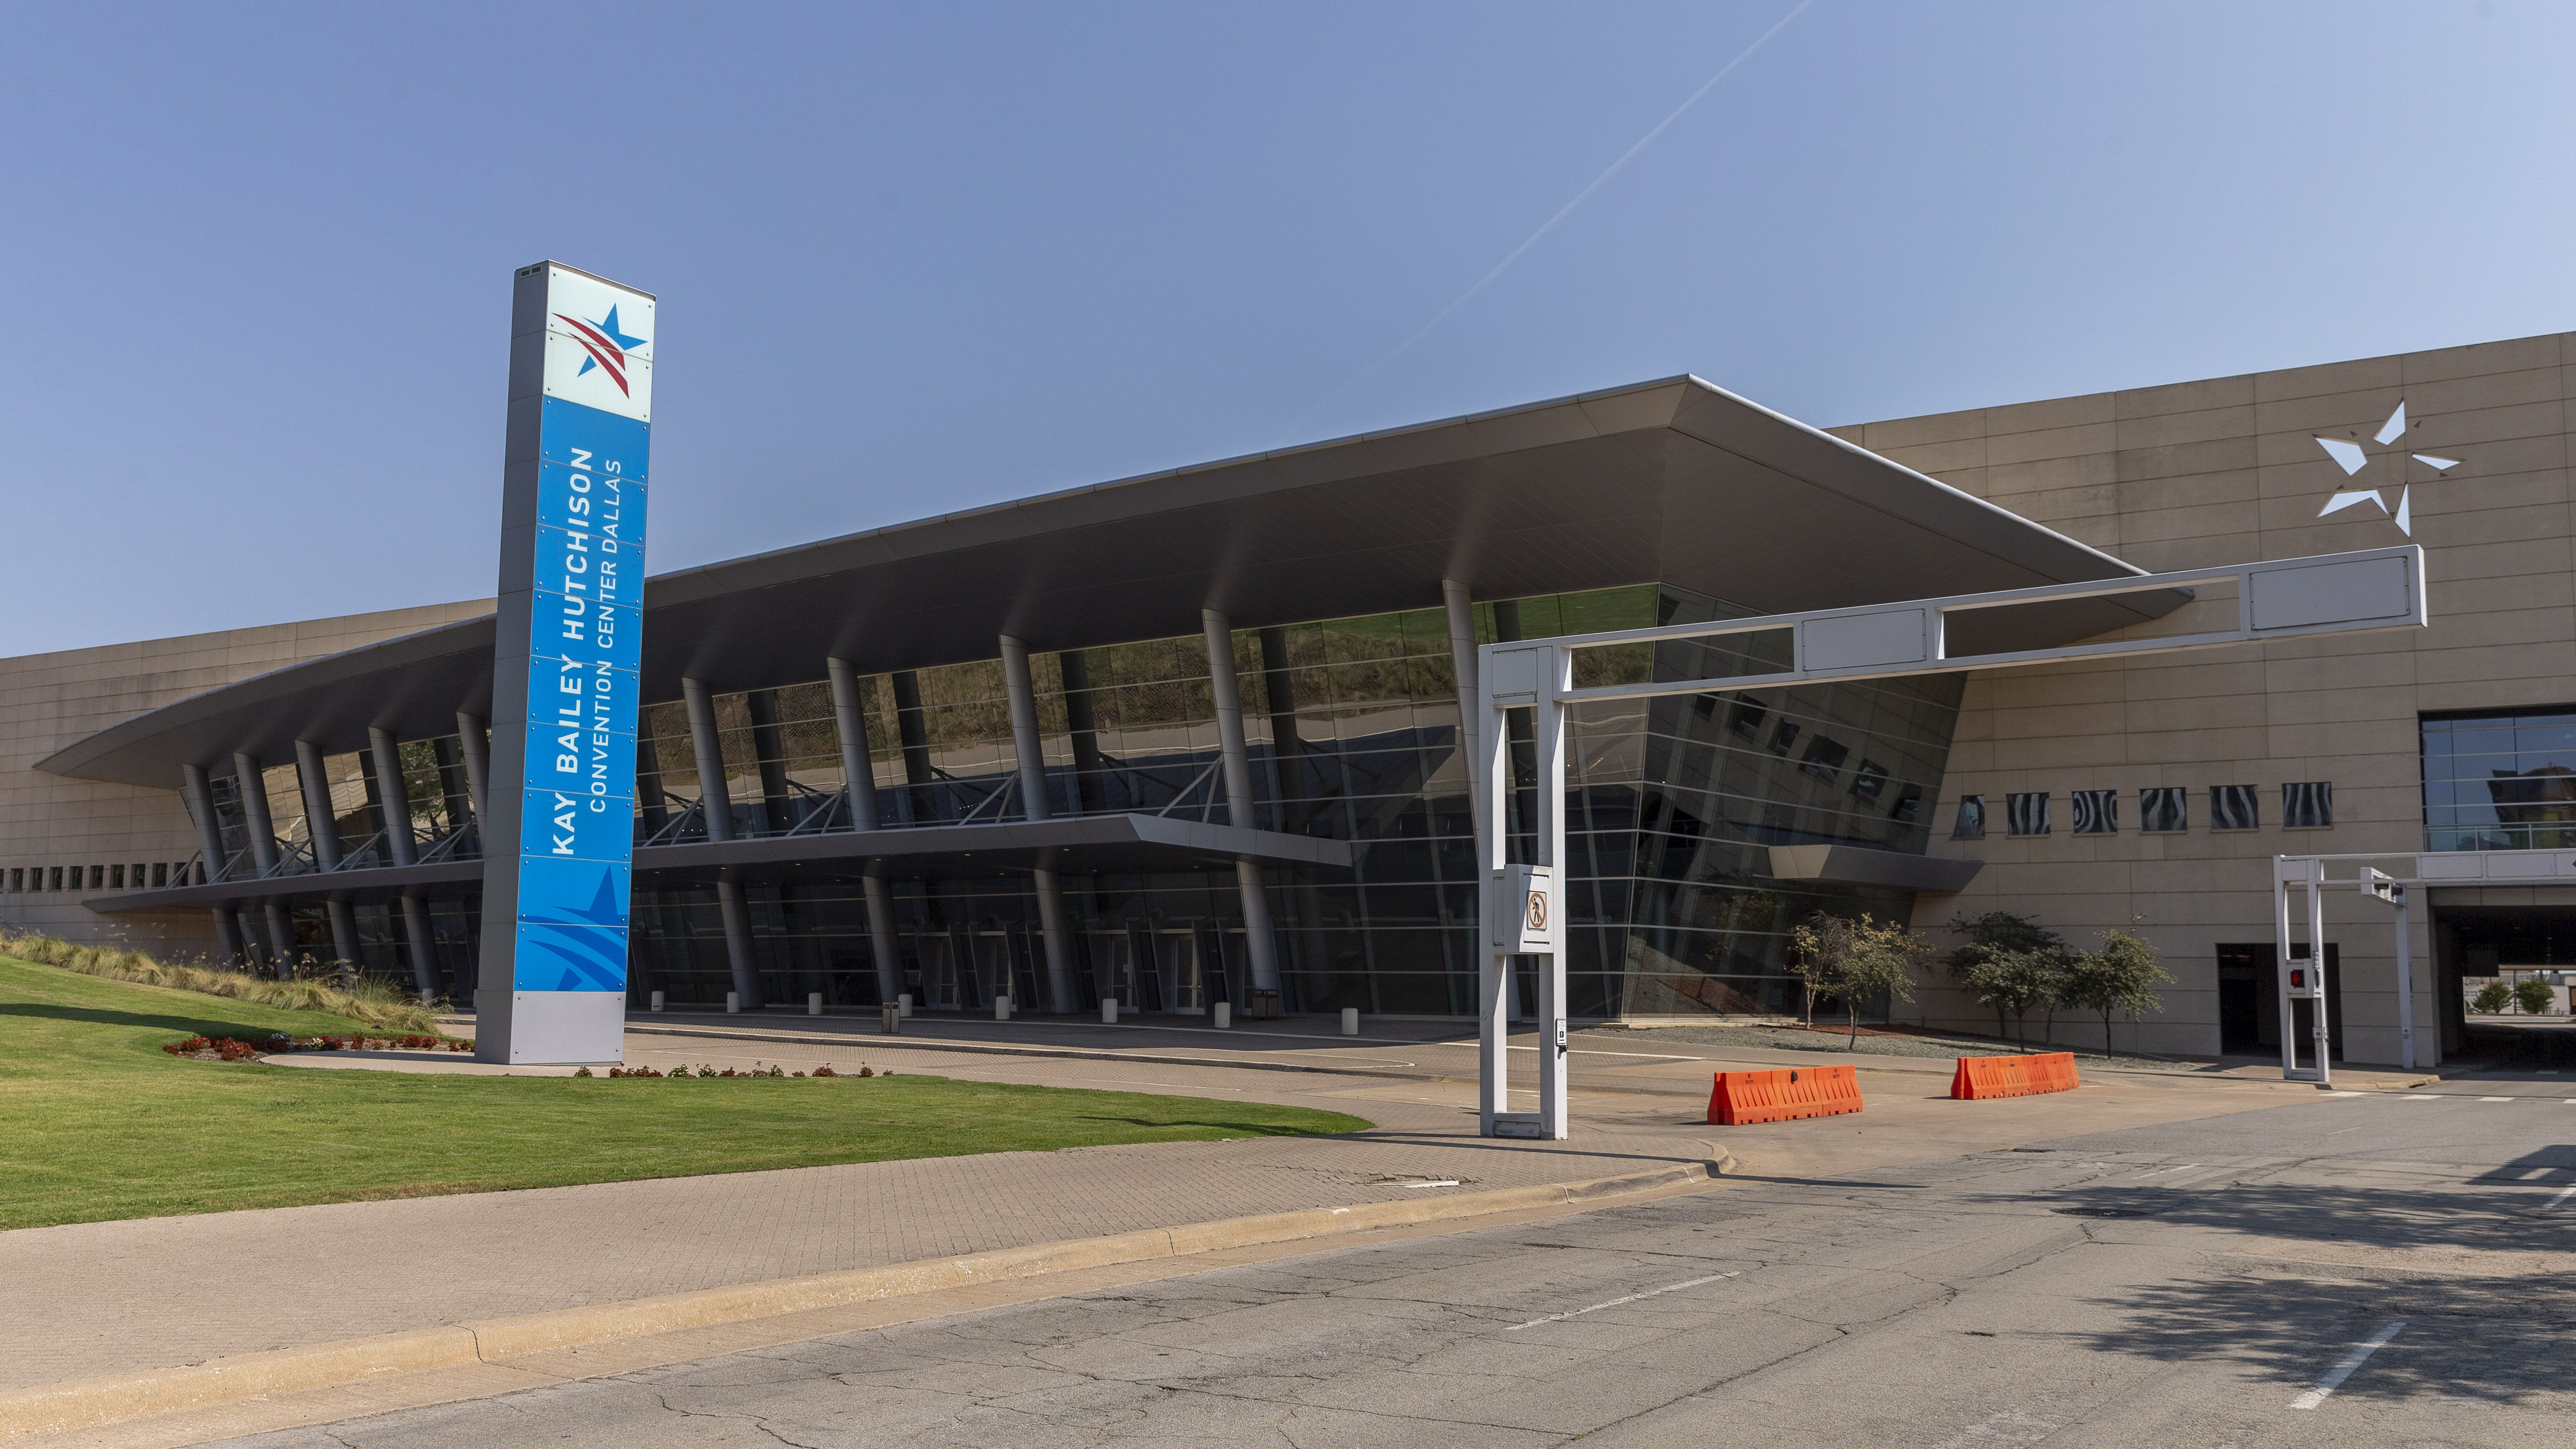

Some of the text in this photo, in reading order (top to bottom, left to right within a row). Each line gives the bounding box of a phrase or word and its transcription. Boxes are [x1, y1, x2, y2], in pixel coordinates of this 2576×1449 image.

[553, 447, 592, 854] KAY BAILEY HUTCHISON
[590, 460, 621, 813] CONVENTION CENTER DALLAS
